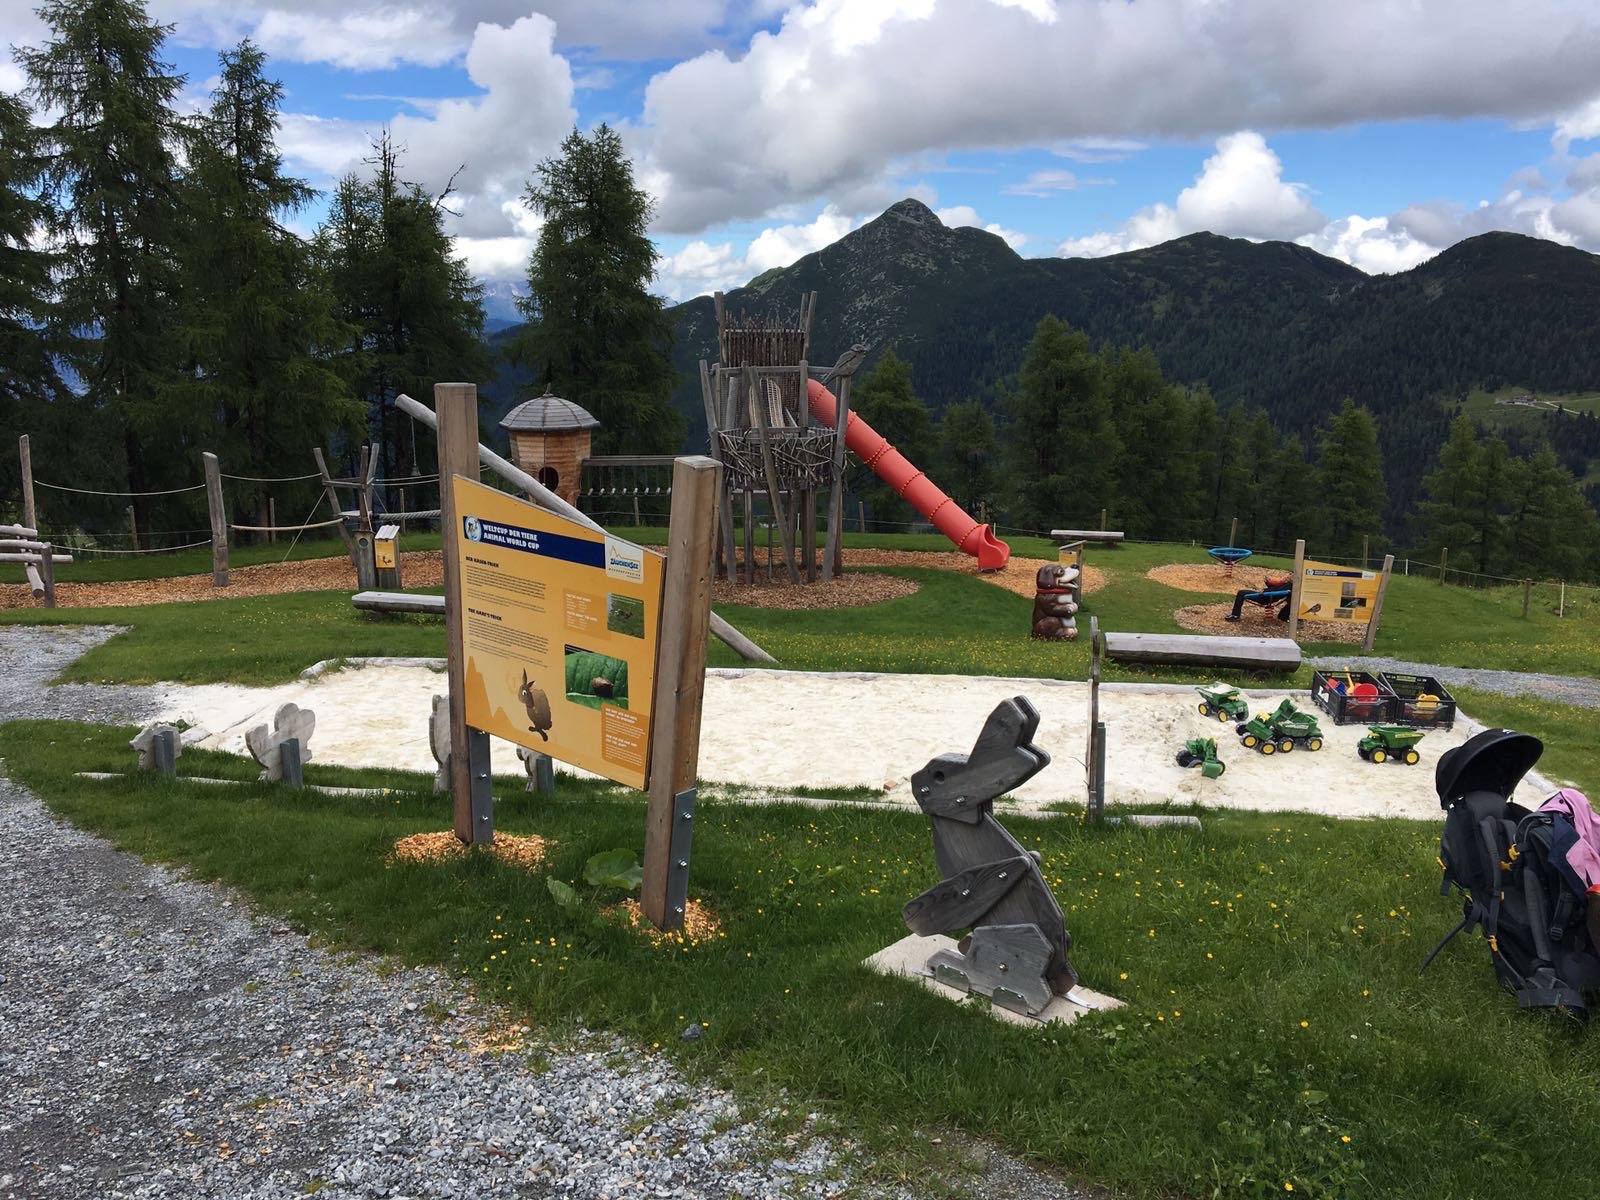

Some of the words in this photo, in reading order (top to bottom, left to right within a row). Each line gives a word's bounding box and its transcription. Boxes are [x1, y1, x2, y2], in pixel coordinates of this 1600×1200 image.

[483, 524, 508, 534] WELTCUP
[509, 529, 520, 538] DER
[521, 532, 537, 541] TIERE
[484, 532, 506, 543] ANIMAL
[506, 537, 527, 547] WORLD
